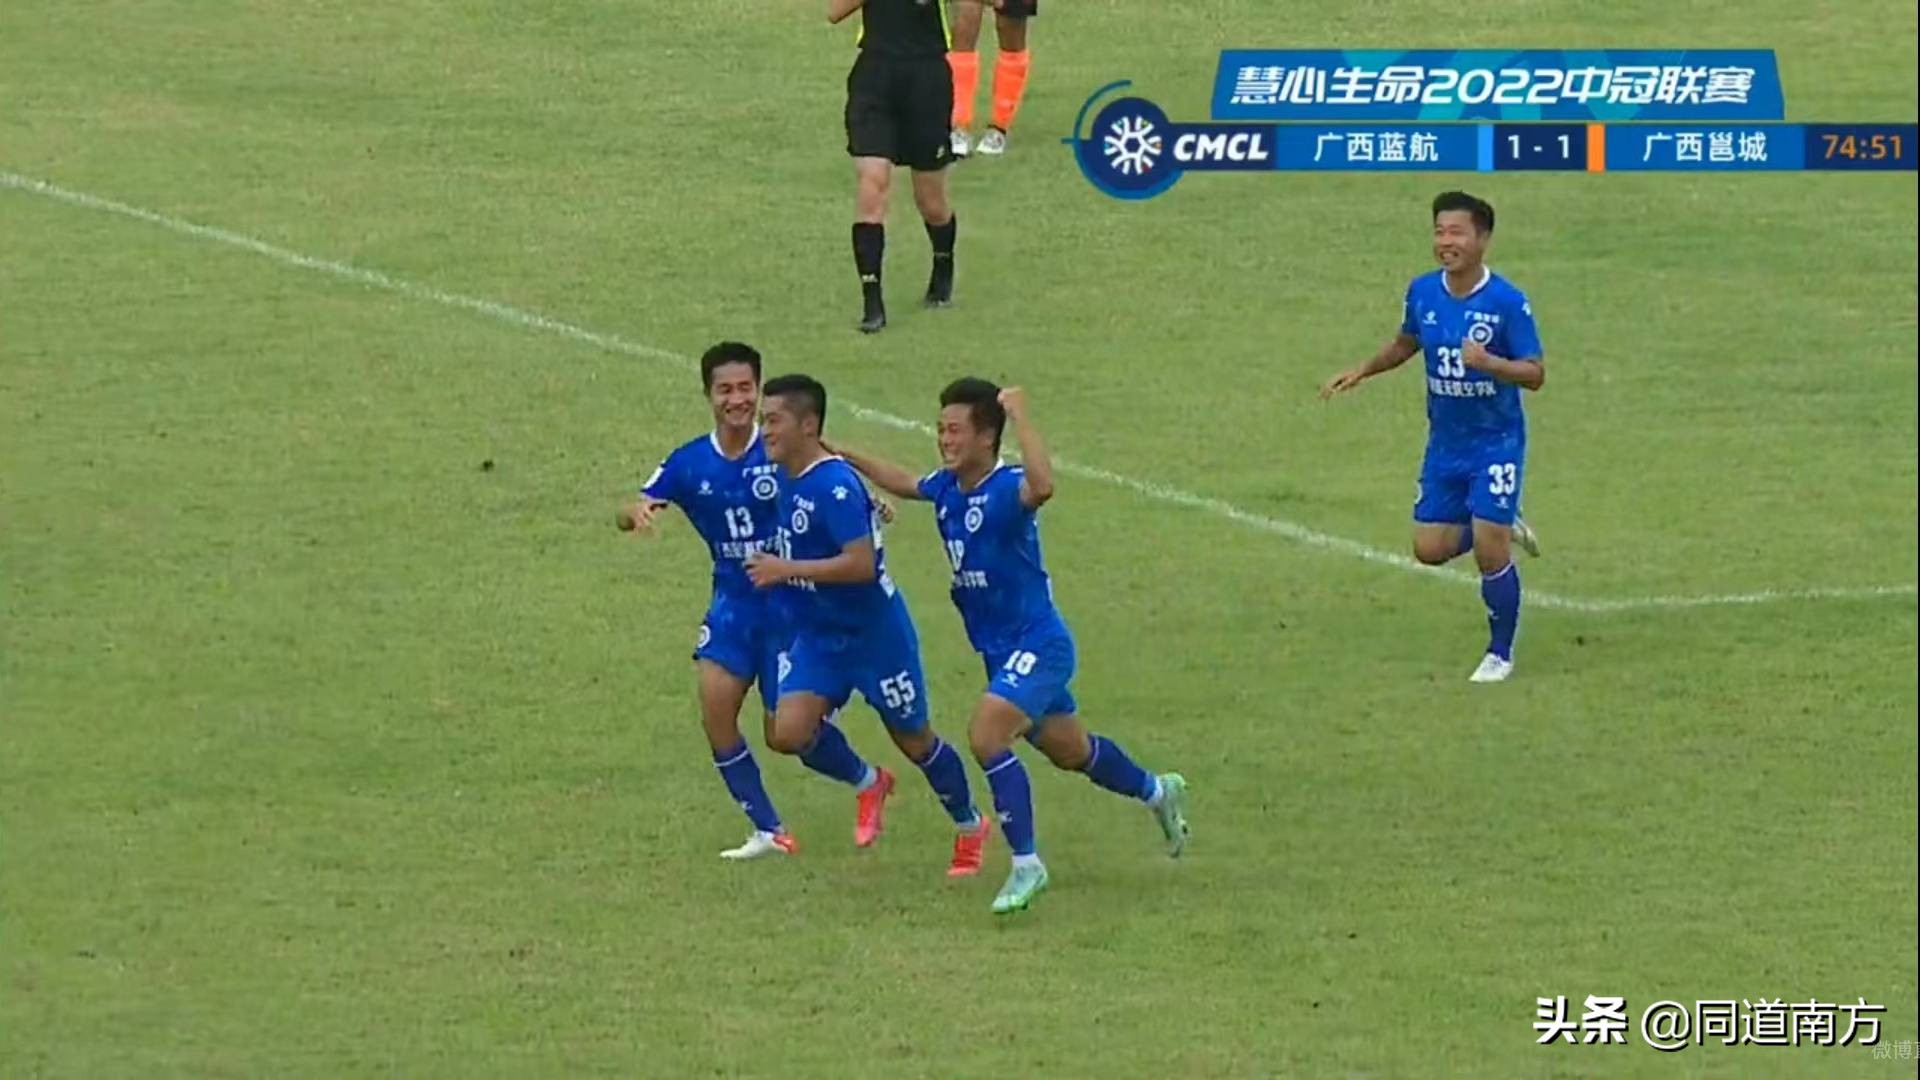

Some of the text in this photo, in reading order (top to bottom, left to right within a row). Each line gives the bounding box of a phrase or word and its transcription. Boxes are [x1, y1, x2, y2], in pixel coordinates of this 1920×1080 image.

[1437, 346, 1465, 378] 33
[1488, 462, 1516, 495] 33
[724, 506, 754, 539] 13
[879, 669, 916, 709] 55
